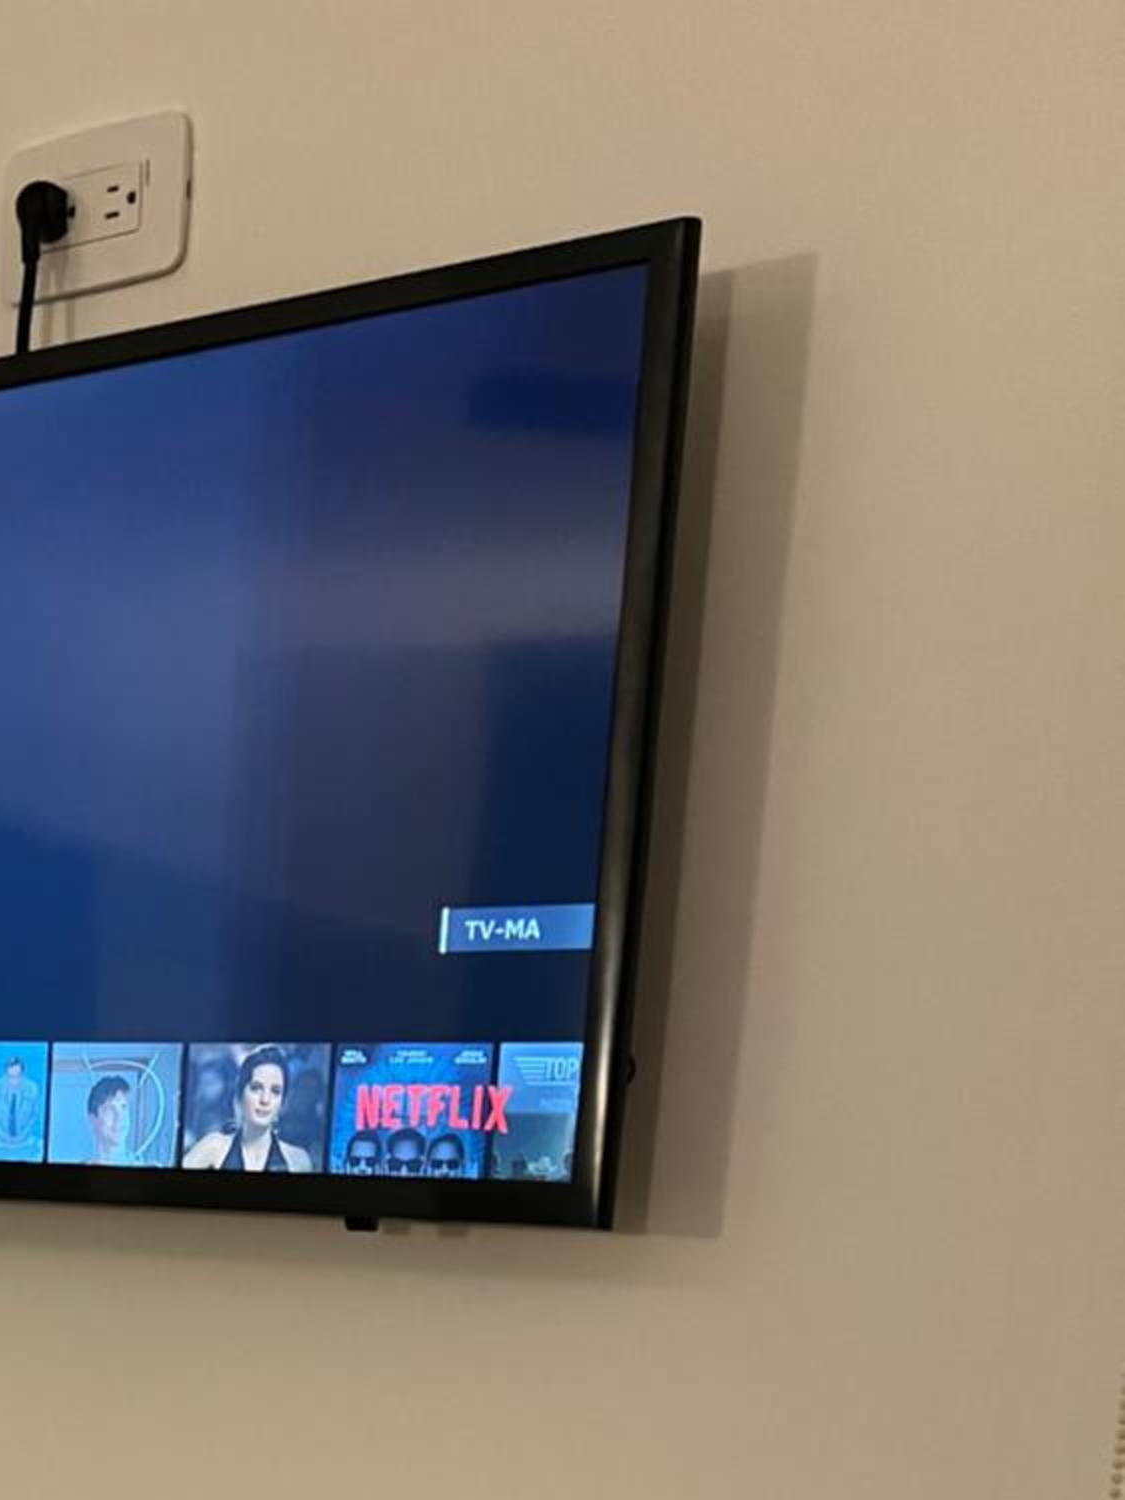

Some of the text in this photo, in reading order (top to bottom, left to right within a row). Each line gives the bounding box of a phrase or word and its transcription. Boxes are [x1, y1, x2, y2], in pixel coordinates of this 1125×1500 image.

[464, 917, 541, 941] TV-MA
[544, 1055, 579, 1083] TOP
[354, 1083, 513, 1134] NETFLIX
